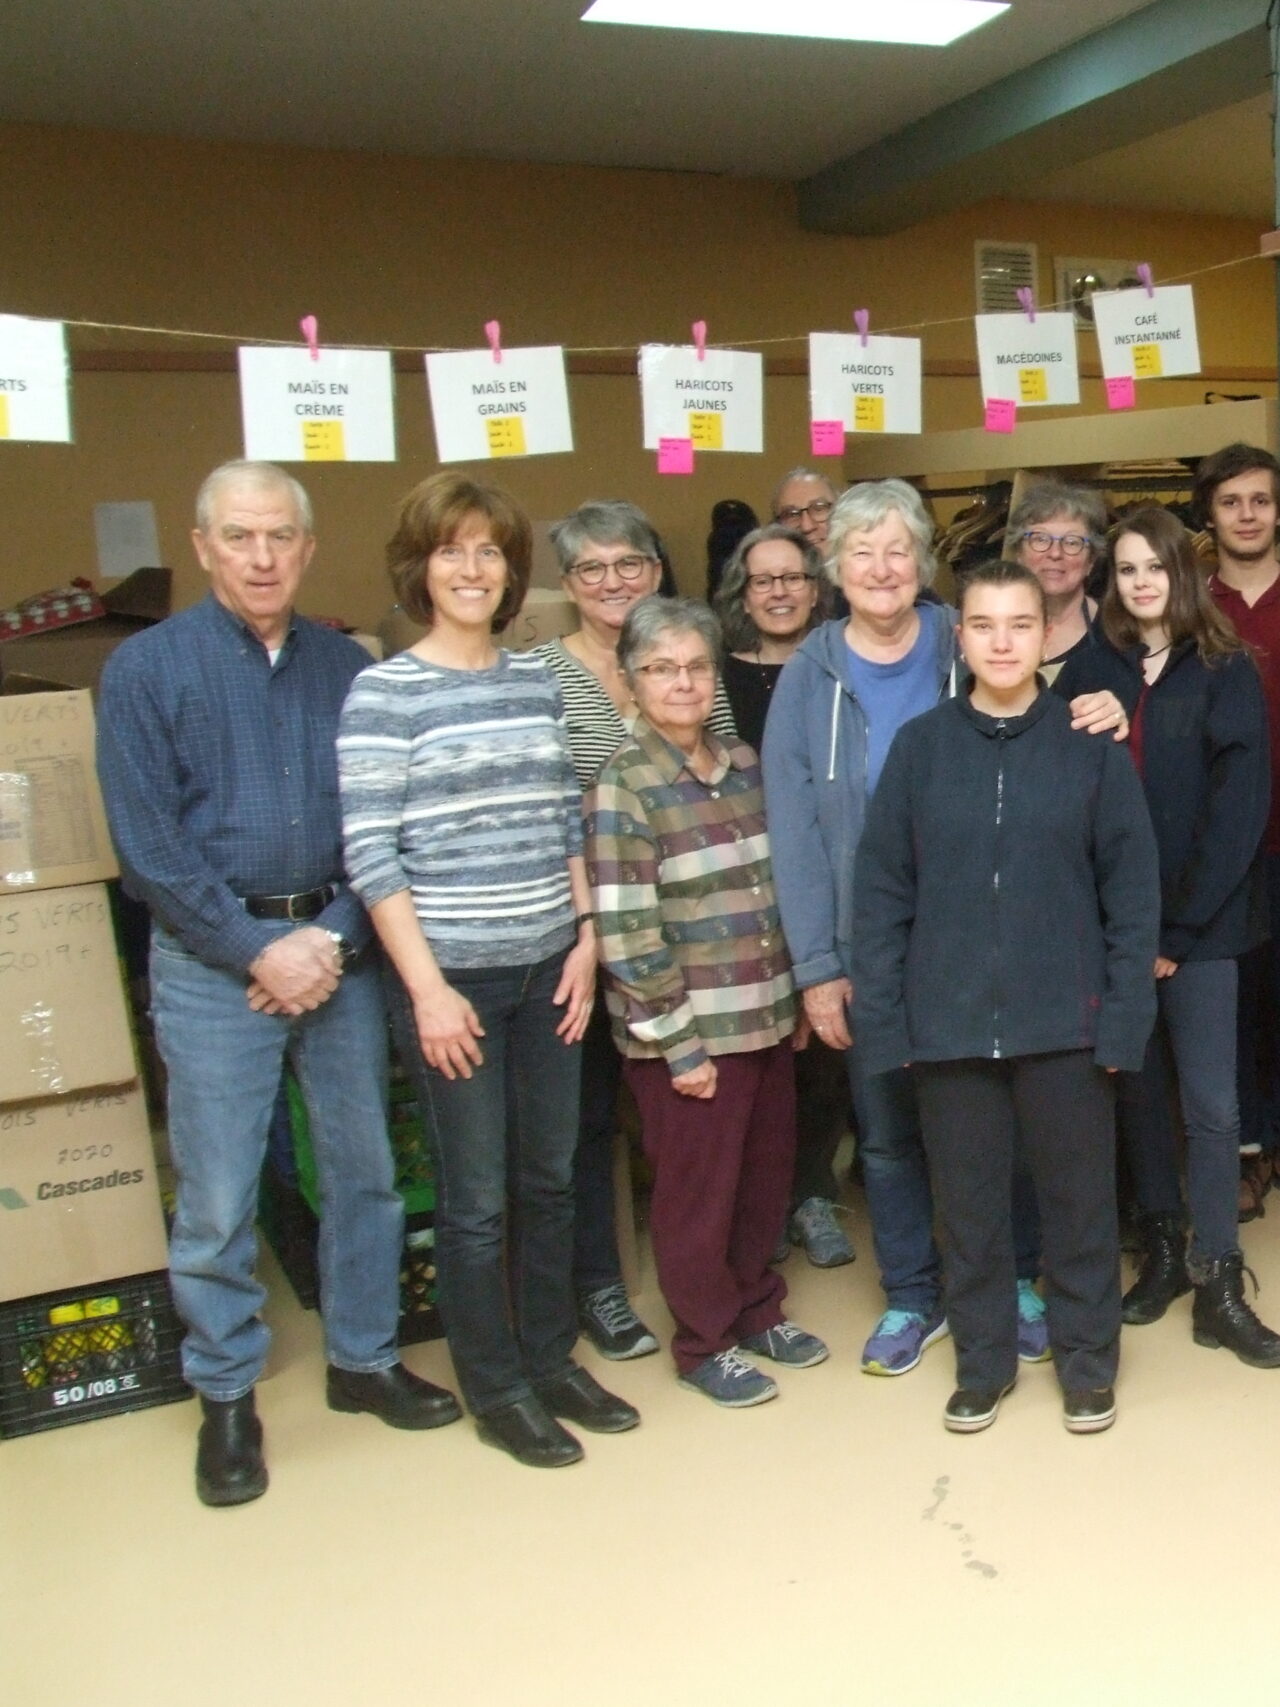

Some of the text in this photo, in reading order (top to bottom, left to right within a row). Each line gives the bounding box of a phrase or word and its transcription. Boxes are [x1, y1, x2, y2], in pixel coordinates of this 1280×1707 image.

[1134, 312, 1158, 326] CAFÉ
[1114, 329, 1182, 345] INSTANTANNÉ
[996, 351, 1063, 365] MACÉDOINES
[841, 364, 895, 377] HARICOTS
[287, 380, 349, 395] MAÏS EN
[472, 380, 527, 395] MAÏS EN
[675, 379, 734, 392] HARICOTS
[851, 383, 885, 394] VERTS
[295, 401, 345, 416] CRÈME
[478, 401, 527, 416] GRAINS
[682, 399, 727, 411] JAUNES
[37, 1168, 145, 1201] Cascades
